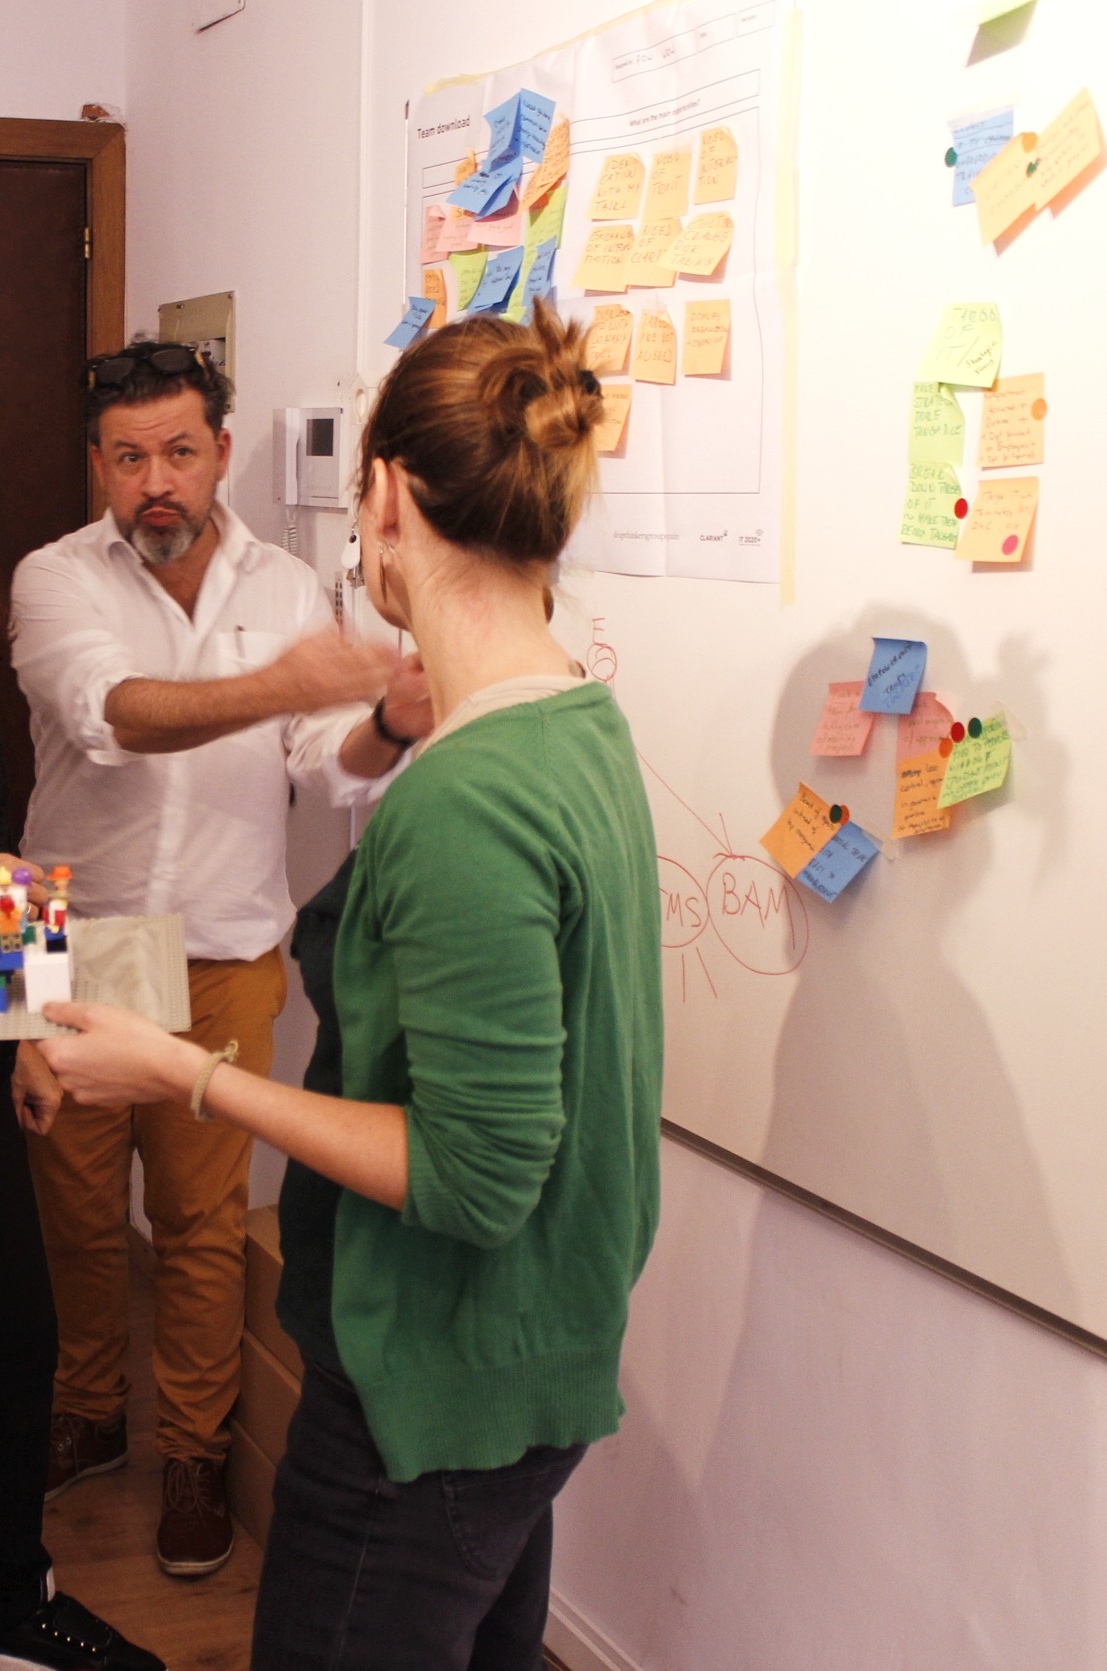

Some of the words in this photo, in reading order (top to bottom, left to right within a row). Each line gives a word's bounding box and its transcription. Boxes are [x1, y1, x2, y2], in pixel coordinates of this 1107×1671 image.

[417, 127, 435, 140] Team
[437, 114, 471, 134] download
[699, 534, 724, 542] CLARIANT
[722, 872, 796, 951] BAM
